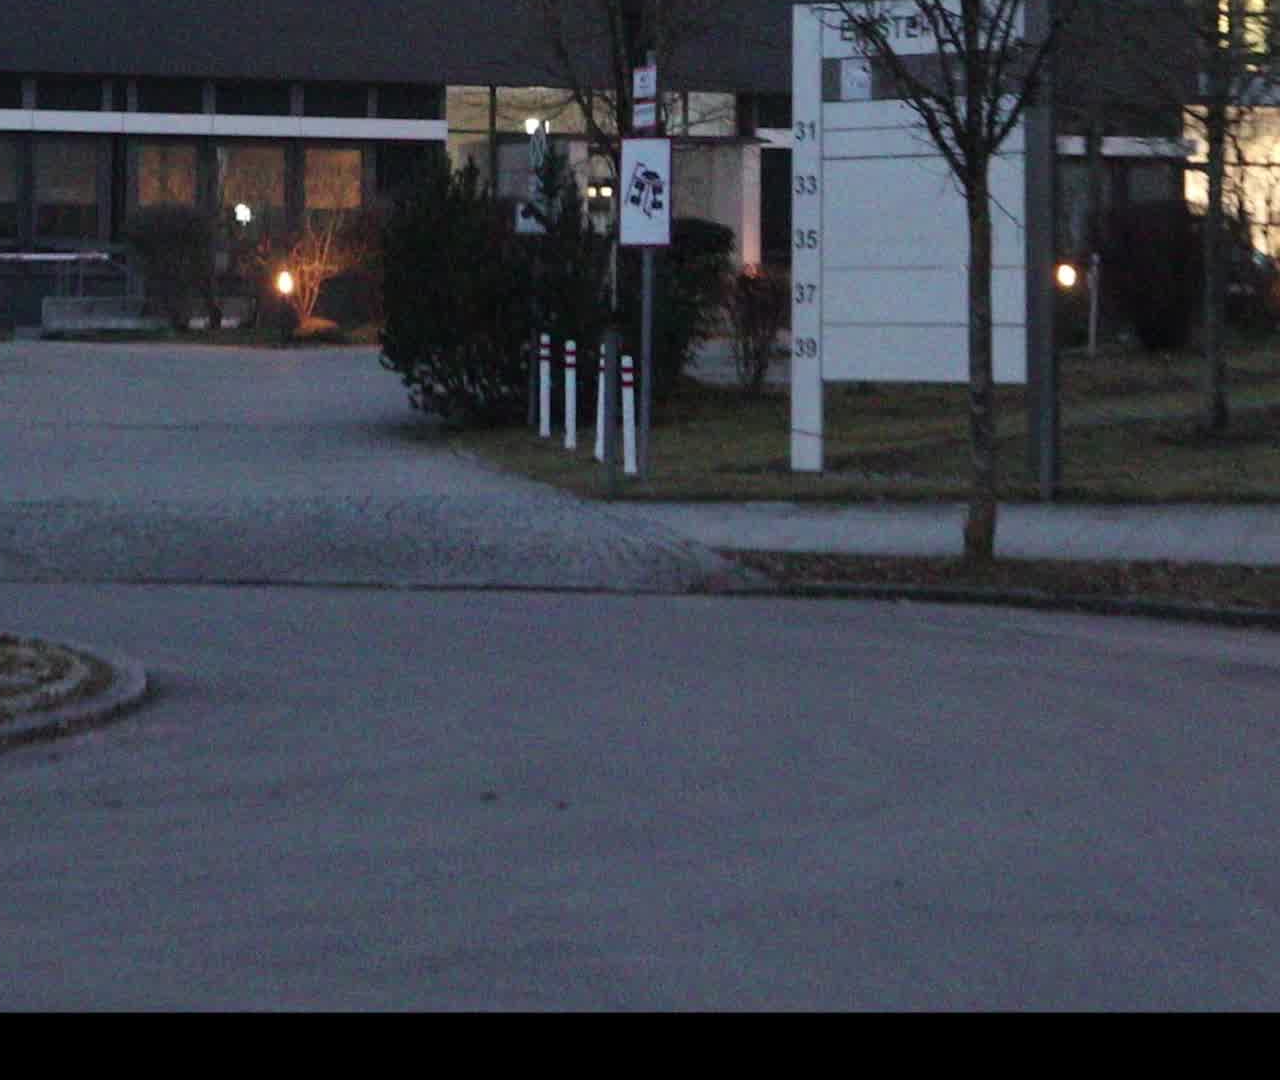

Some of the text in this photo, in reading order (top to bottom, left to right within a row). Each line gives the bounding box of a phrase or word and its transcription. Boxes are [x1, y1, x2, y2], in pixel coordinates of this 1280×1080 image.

[794, 121, 816, 141] 31
[795, 175, 816, 194] 33
[795, 229, 816, 249] 35
[795, 283, 816, 304] 37
[795, 337, 816, 358] 39
